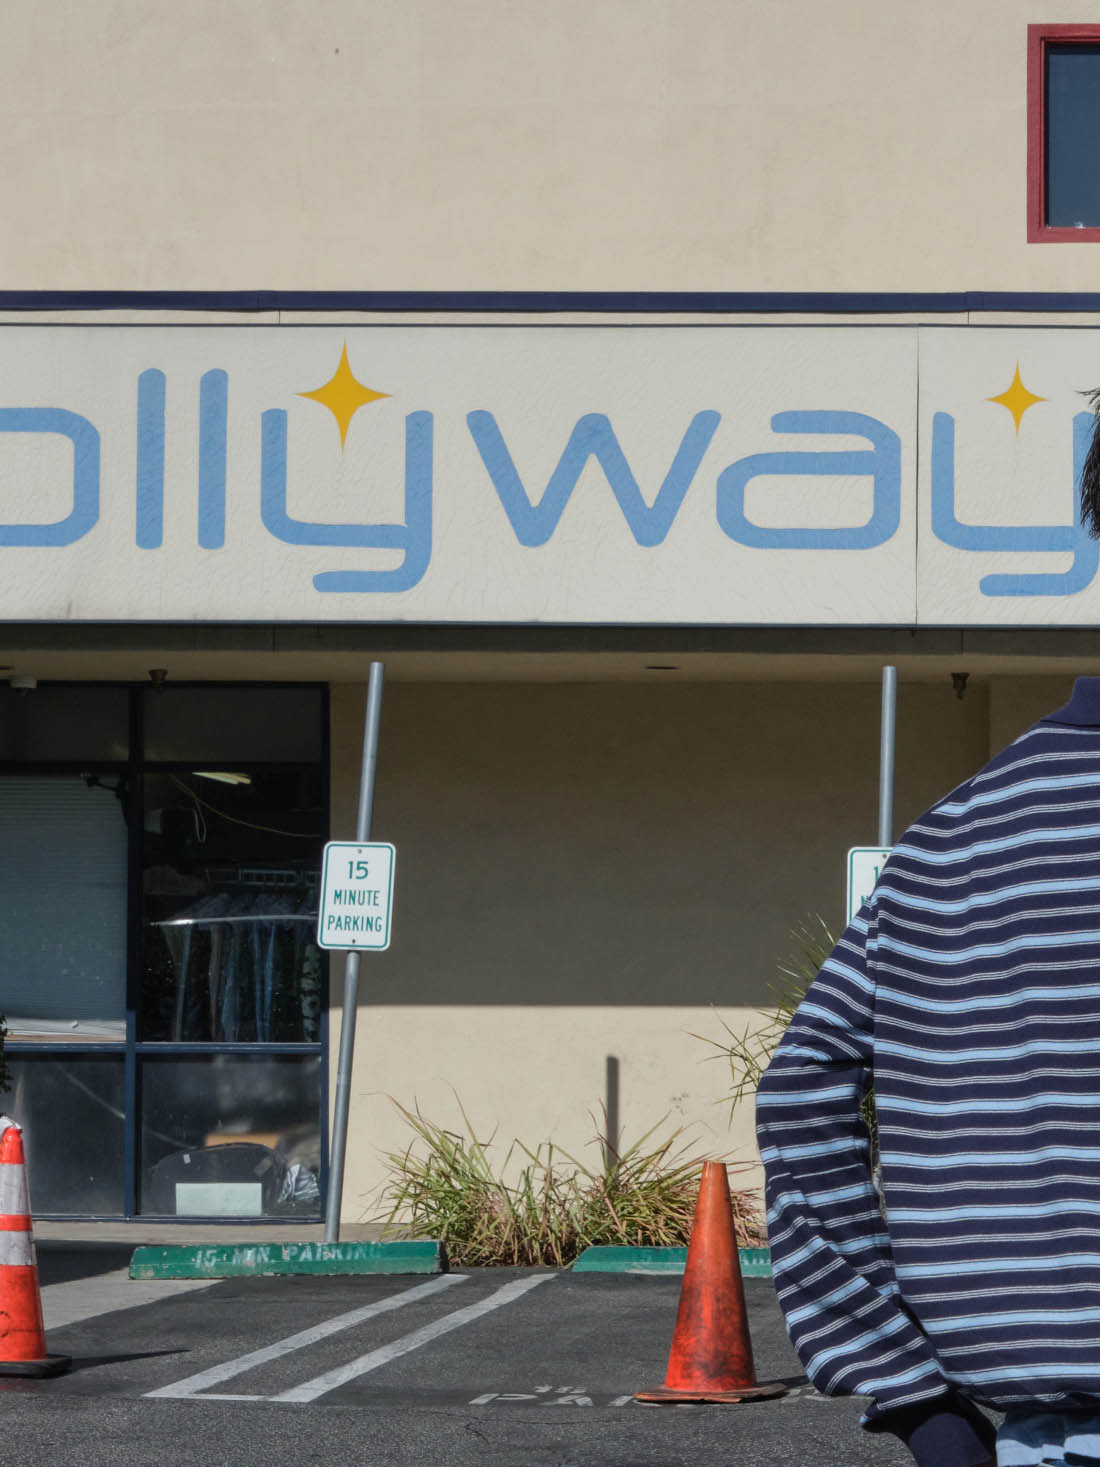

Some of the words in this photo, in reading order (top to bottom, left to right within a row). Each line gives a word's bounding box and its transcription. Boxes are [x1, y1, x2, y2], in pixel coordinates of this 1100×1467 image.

[348, 861, 369, 880] 15
[333, 889, 380, 907] MINUTE
[328, 915, 383, 933] PARKING
